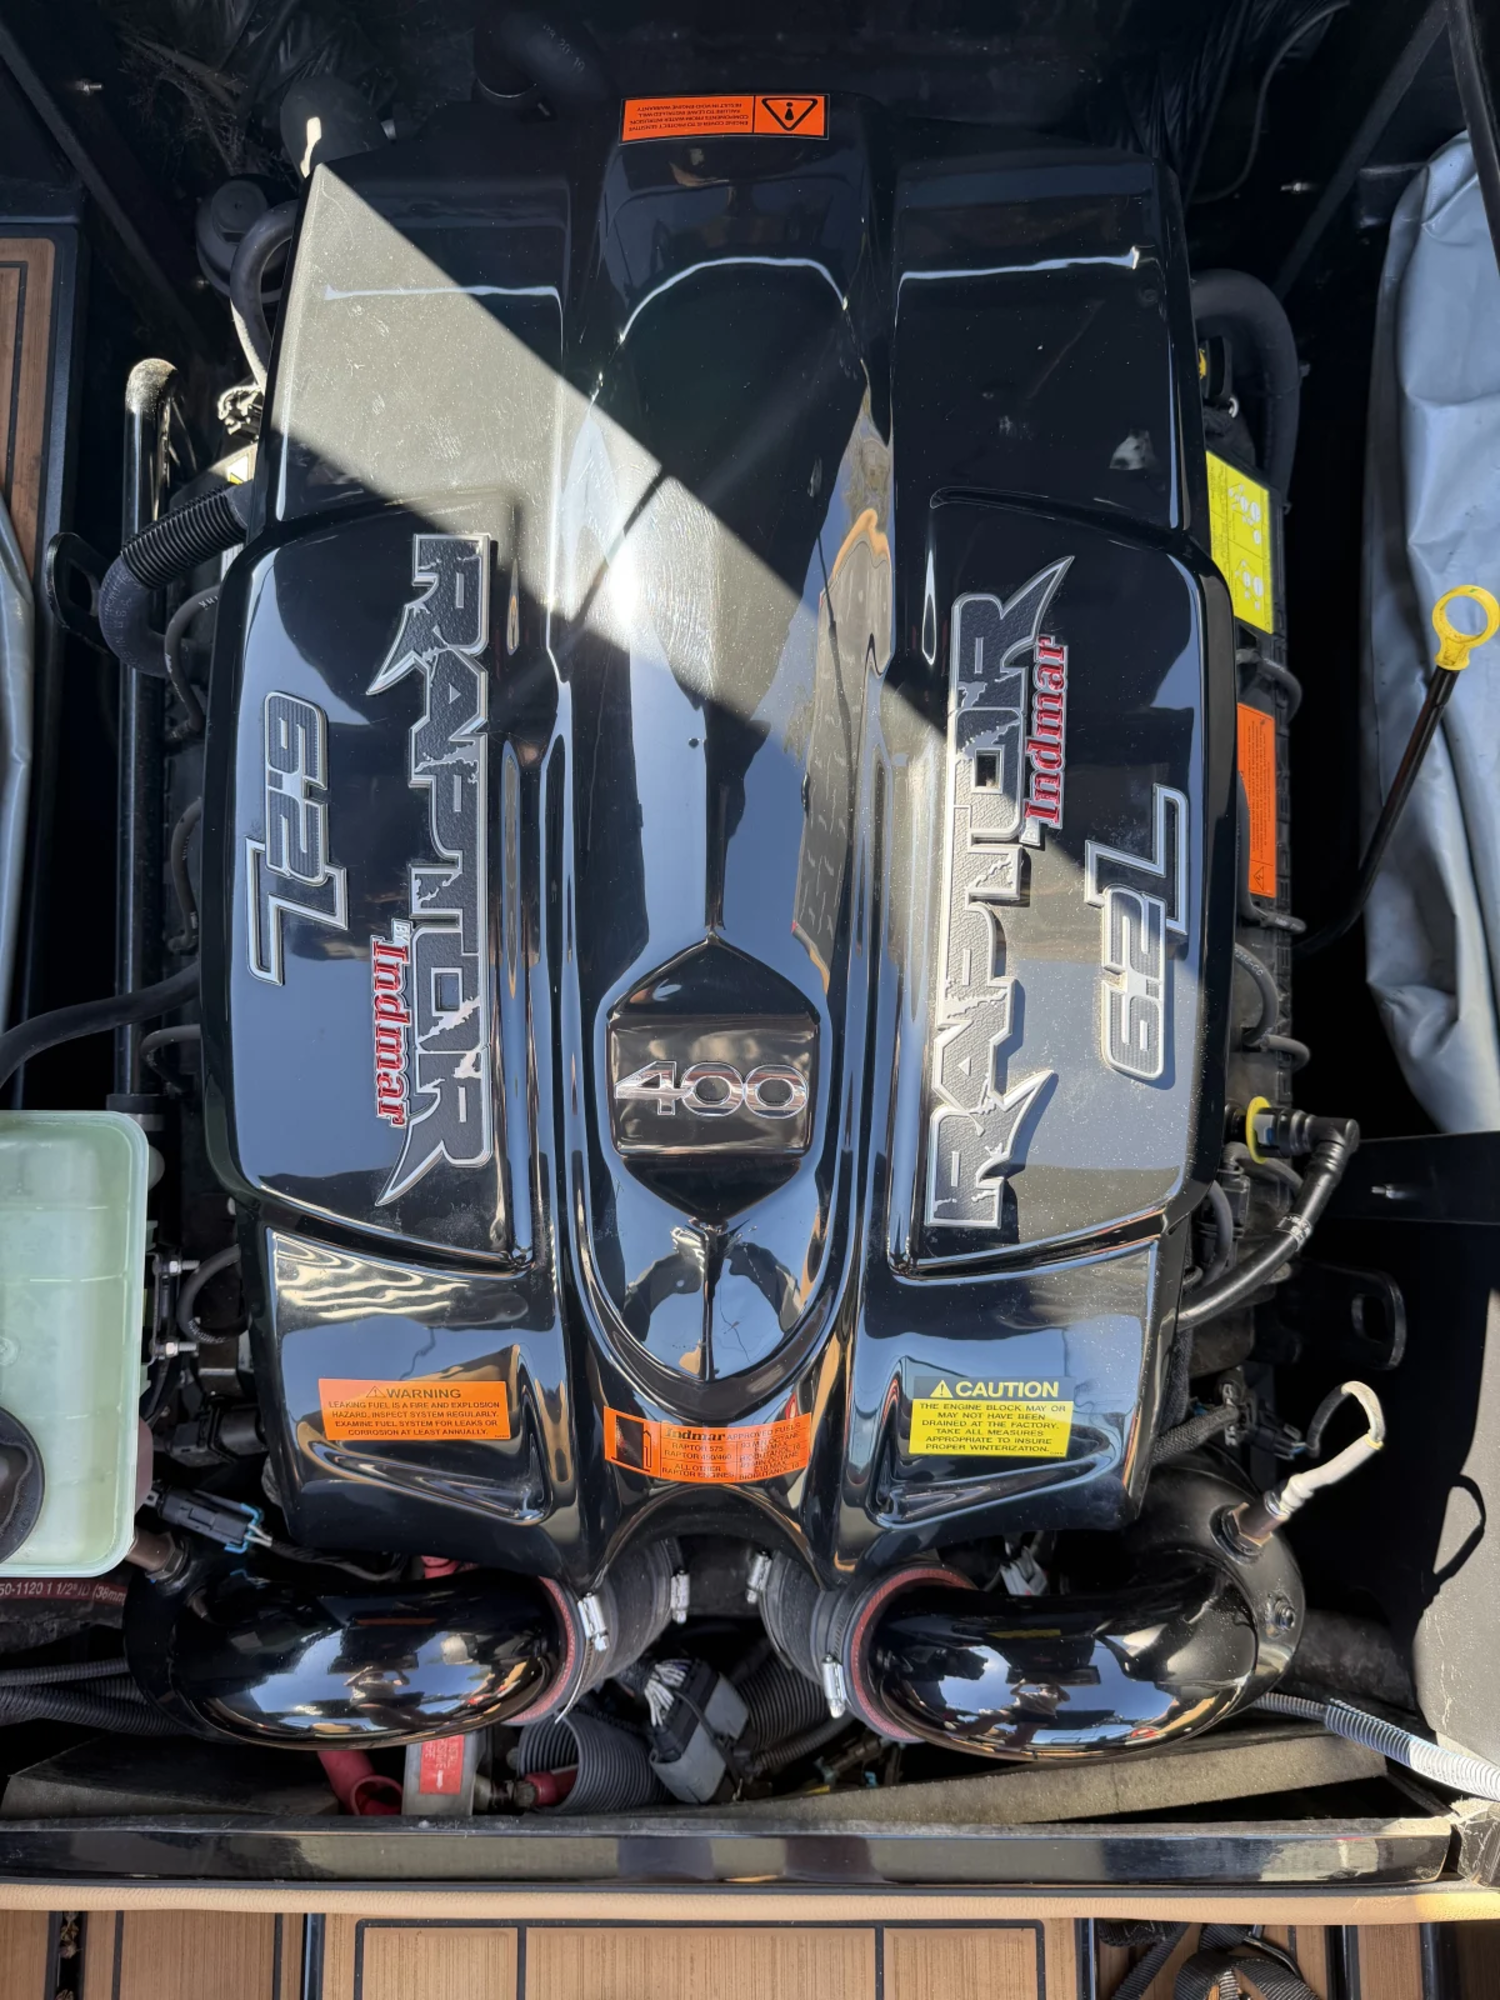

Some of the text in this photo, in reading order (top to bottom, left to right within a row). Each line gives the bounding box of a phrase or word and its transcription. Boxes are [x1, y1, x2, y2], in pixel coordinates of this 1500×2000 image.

[1024, 634, 1068, 829] Indmar
[366, 533, 492, 1206] RAPTOR
[924, 555, 1075, 1228] RAPTOR
[370, 935, 412, 1128] Indmar
[614, 1060, 808, 1119] 400
[386, 1388, 461, 1399] WARNING
[955, 1381, 1059, 1398] CAUTION
[329, 1401, 366, 1409] LEAKING
[944, 1403, 981, 1411] ENGINE
[664, 1421, 801, 1441] Indmar APPROVED FUELS
[671, 1442, 724, 1453] RAPTOR 575
[970, 1444, 1049, 1452] WINTERIZATION.
[664, 1450, 700, 1460] RAPTOR
[661, 1467, 697, 1478] RAPTOR
[674, 1463, 721, 1472] ALL OTHER
